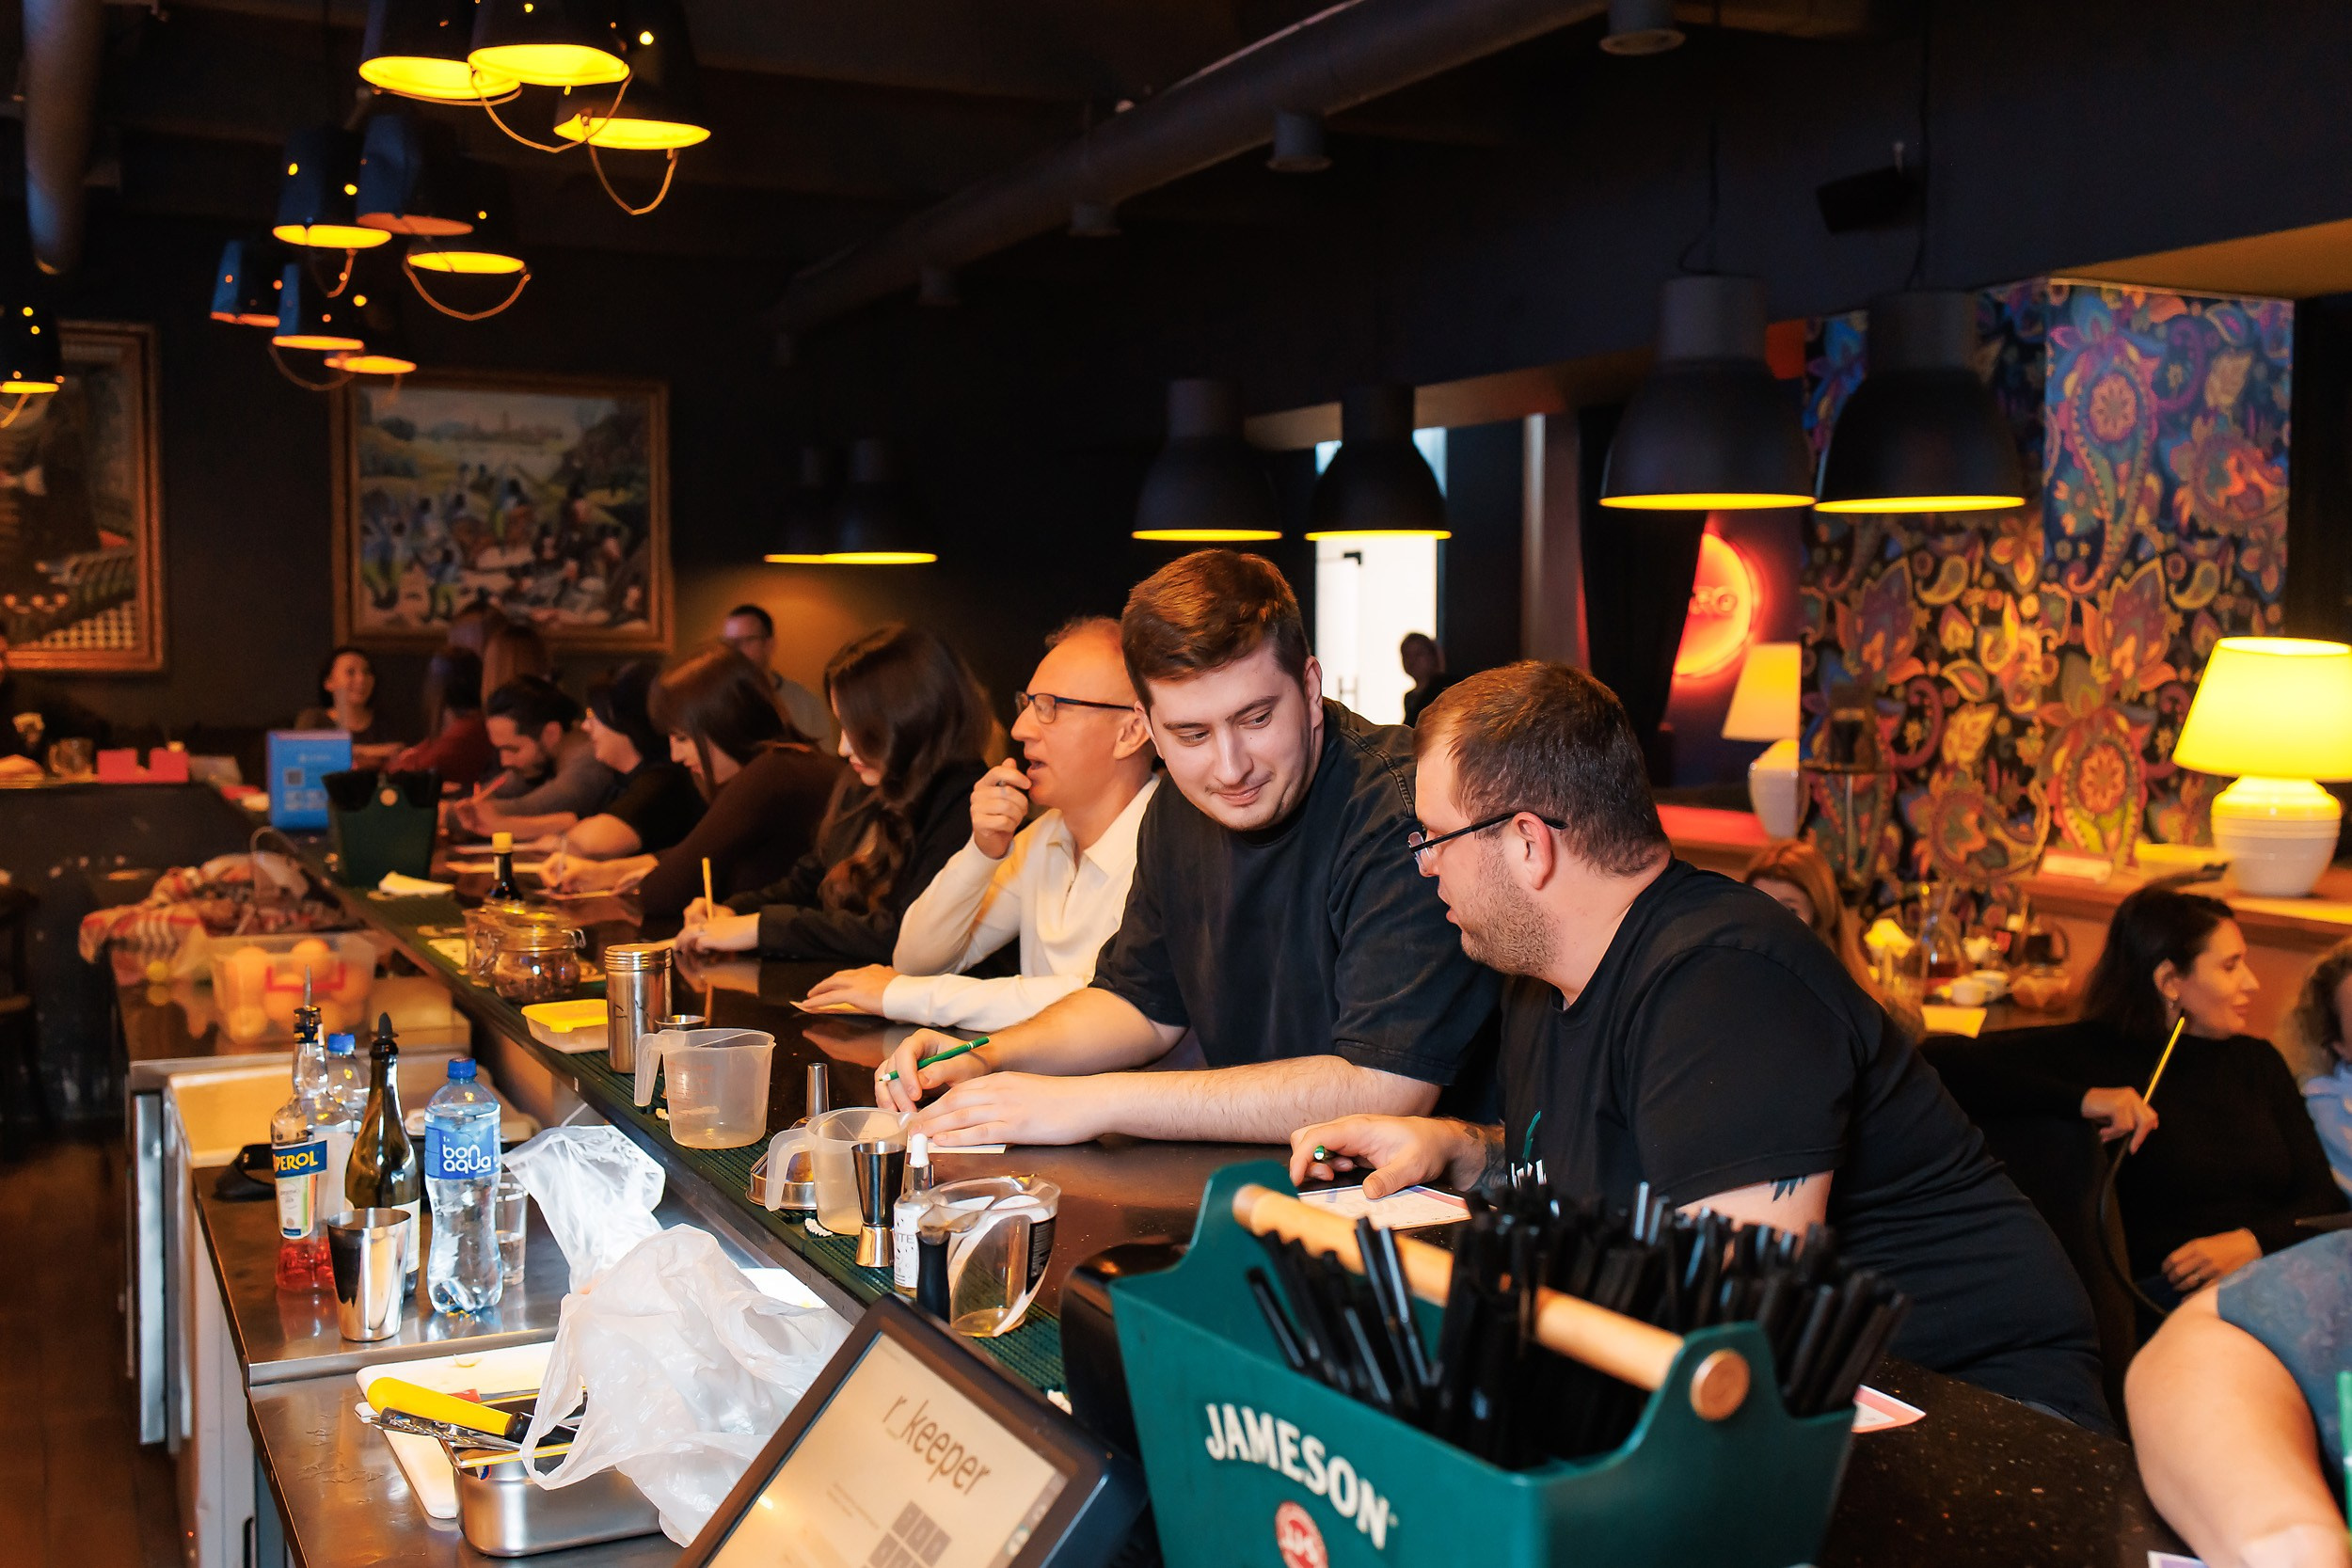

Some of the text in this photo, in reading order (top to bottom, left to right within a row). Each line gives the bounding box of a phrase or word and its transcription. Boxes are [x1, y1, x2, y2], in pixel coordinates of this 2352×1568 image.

[442, 1144, 481, 1160] bon
[442, 1155, 492, 1175] aqua
[896, 1231, 915, 1244] ITE
[882, 1394, 993, 1496] r_keeper
[1204, 1402, 1391, 1550] JAMESON
